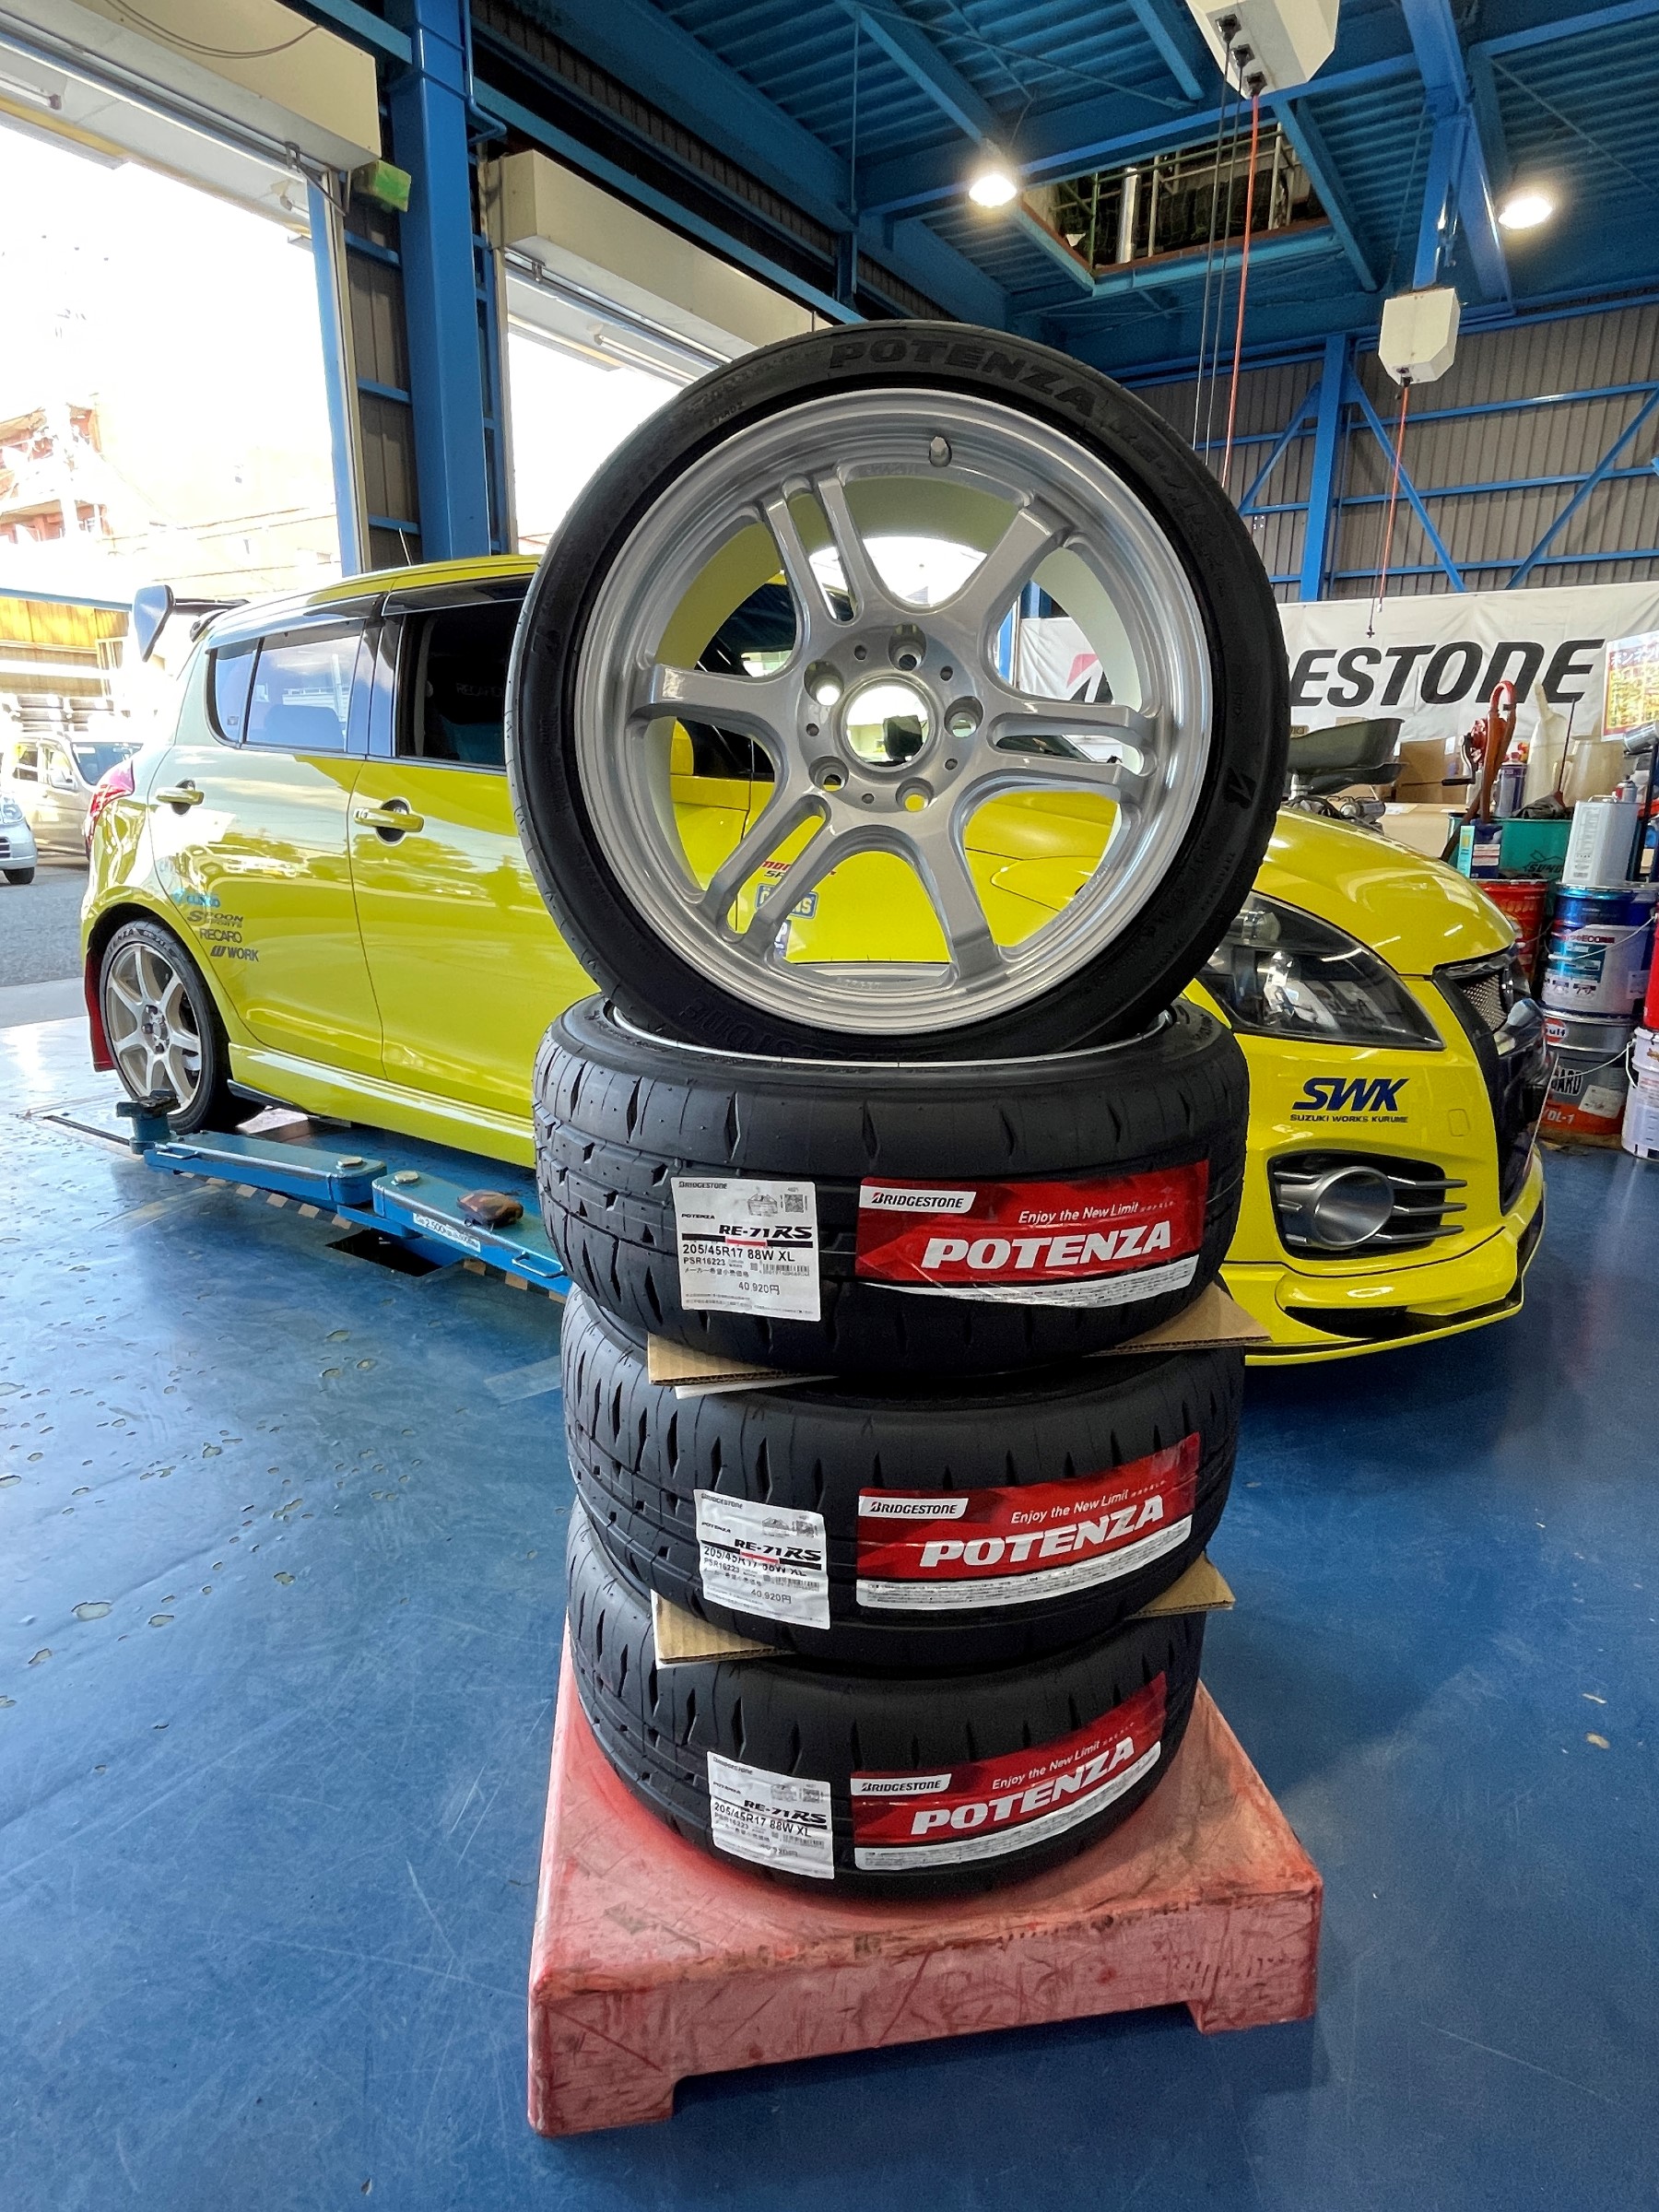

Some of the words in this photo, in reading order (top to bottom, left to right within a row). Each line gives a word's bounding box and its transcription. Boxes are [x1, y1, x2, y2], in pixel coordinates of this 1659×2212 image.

[827, 337, 1099, 418] POTENZA
[1290, 638, 1606, 708] ESTONE
[1527, 863, 1564, 883] SUNO
[186, 911, 244, 923] SPOON
[199, 927, 242, 944] RECARO
[227, 946, 260, 962] WORK
[1546, 1026, 1566, 1037] ulf
[1292, 1077, 1410, 1112] SWK
[1290, 1113, 1329, 1122] SUZUKI
[1332, 1114, 1369, 1123] WORKS
[678, 1181, 728, 1189] BRIDGESTONE
[871, 1192, 964, 1208] BRIDGESTONE
[1018, 1209, 1055, 1225] Enjoy
[1059, 1208, 1080, 1222] the
[1082, 1206, 1110, 1219] New
[1111, 1202, 1139, 1217] Limit
[719, 1224, 813, 1240] RE-71RS
[682, 1243, 743, 1259] 205/45R17
[747, 1249, 774, 1261] 88W
[778, 1251, 795, 1262] XL
[921, 1221, 1171, 1269] POTENZA
[683, 1257, 726, 1266] PSR16223
[869, 1500, 958, 1515] BRIDGESTONE
[1011, 1510, 1048, 1524] Enjoy
[1051, 1505, 1071, 1519] the
[1074, 1500, 1100, 1513] New
[1100, 1488, 1130, 1509] Limit
[920, 1494, 1164, 1567] POTENZA
[734, 1538, 822, 1562] RE-71RS
[993, 1775, 1026, 1791] Enjoy
[1029, 1766, 1046, 1779] the
[1050, 1758, 1075, 1771] New
[1074, 1740, 1101, 1760] Limit
[861, 1779, 942, 1792] BRIDGESTONE
[911, 1736, 1135, 1835] POTENZA
[714, 1802, 767, 1827] 205/45R17
[769, 1820, 794, 1834] 88W
[796, 1826, 812, 1838] XL
[744, 1799, 828, 1824] RE-71RS
